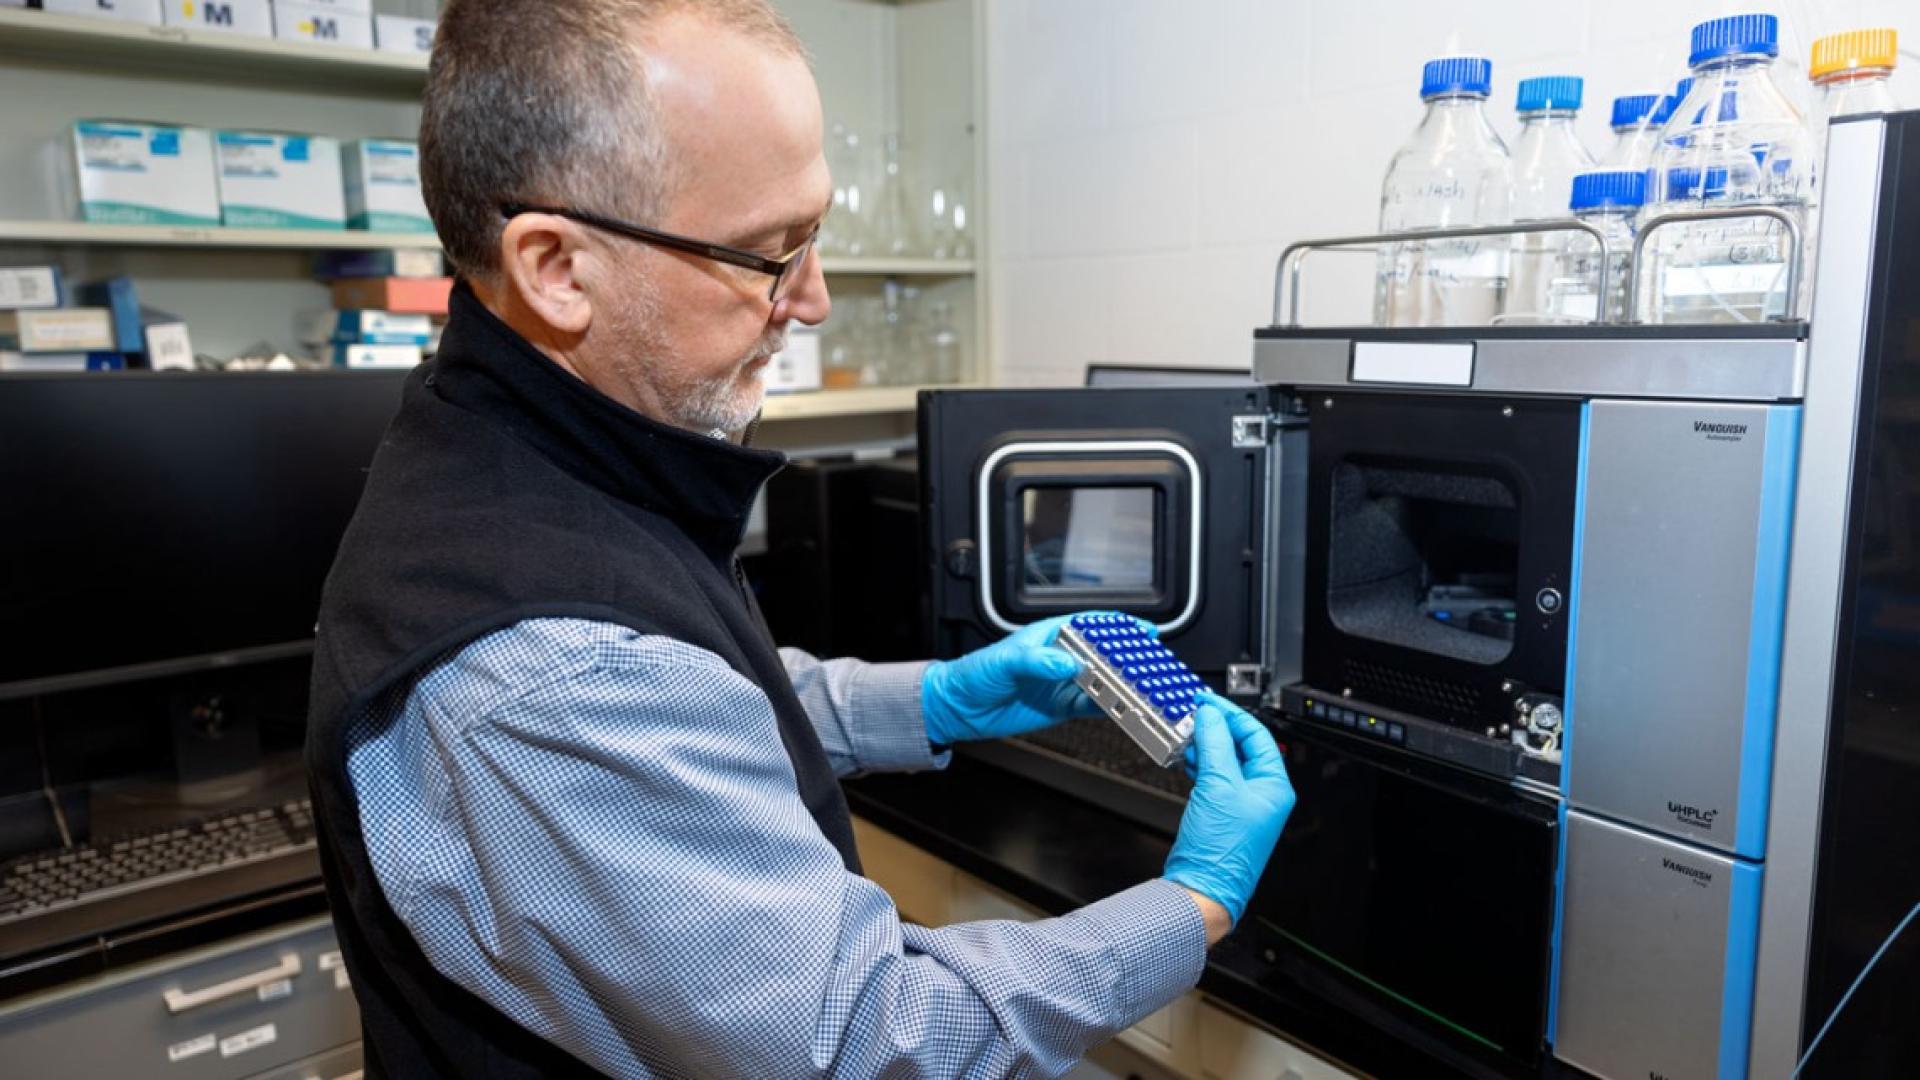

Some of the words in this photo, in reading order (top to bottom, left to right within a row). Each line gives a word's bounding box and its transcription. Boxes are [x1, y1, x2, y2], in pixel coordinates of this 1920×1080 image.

[203, 2, 233, 26] M
[311, 15, 338, 40] M
[1694, 421, 1748, 434] VANQUISH
